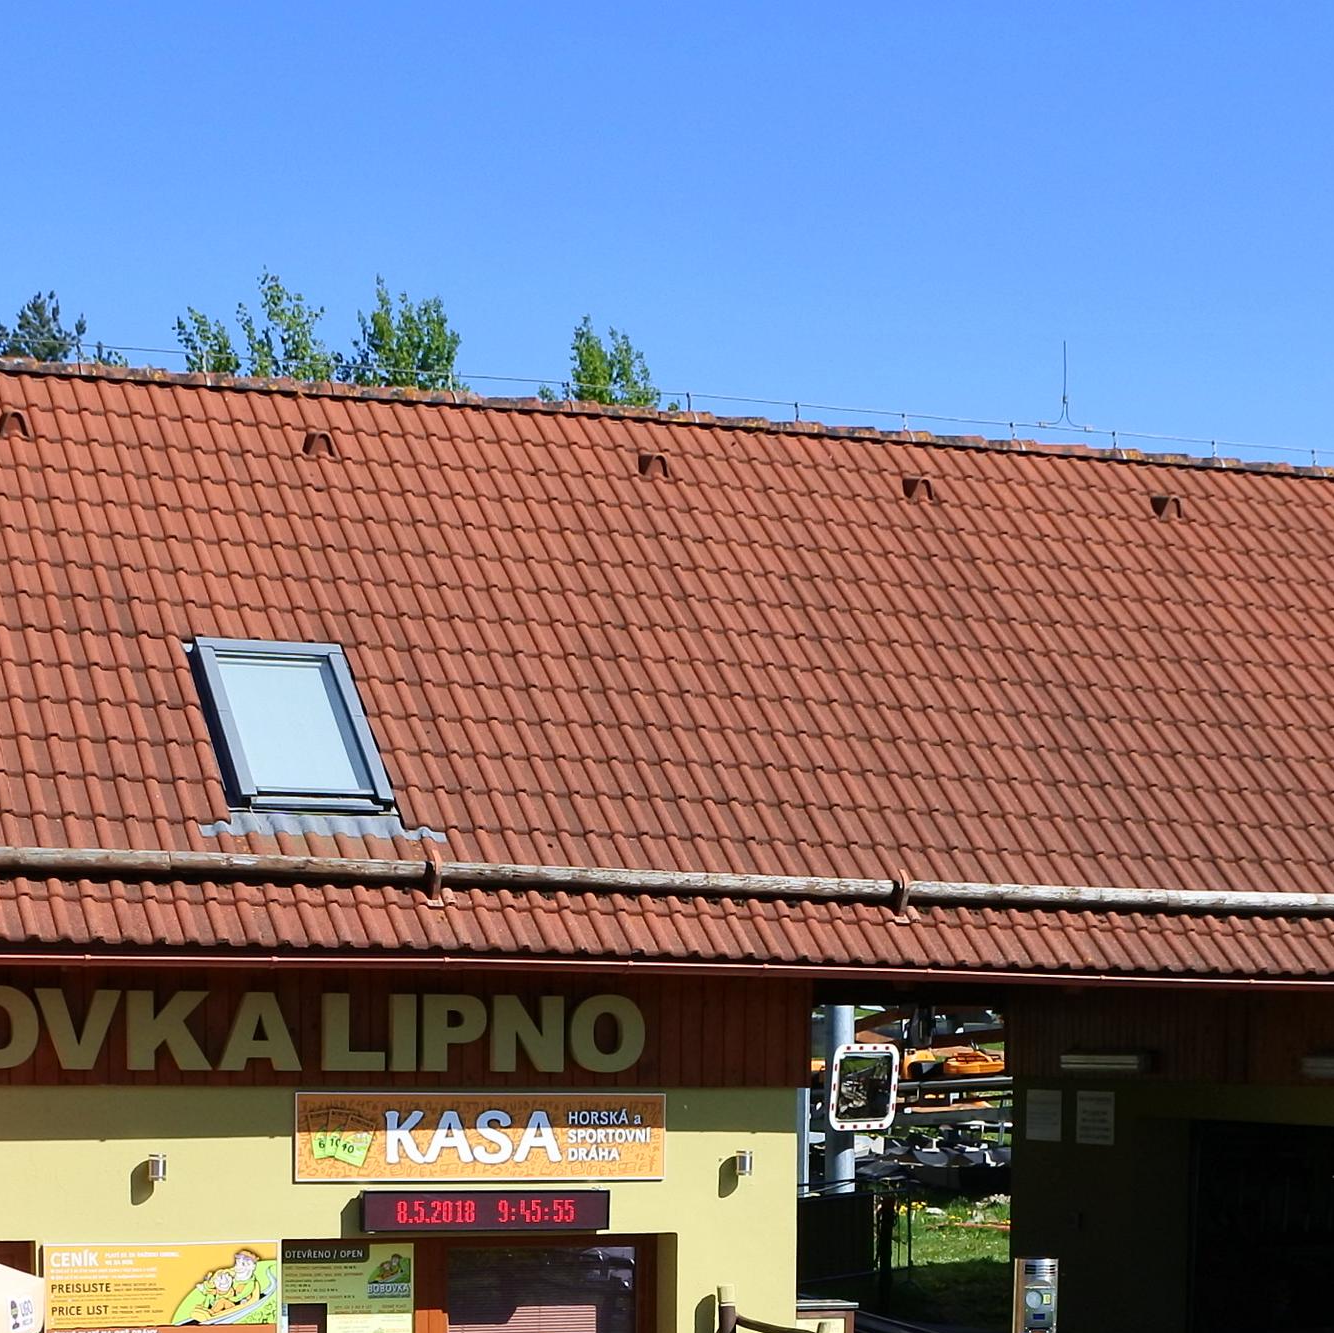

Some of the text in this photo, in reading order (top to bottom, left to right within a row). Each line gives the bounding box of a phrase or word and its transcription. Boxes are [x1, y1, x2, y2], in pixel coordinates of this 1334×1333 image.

[321, 993, 645, 1073] LIPNO
[568, 1109, 642, 1125] HORSKÁ a
[385, 1110, 562, 1164] KASA
[567, 1127, 651, 1144] SPORTOVNÍ
[318, 1140, 326, 1149] 6
[567, 1145, 620, 1162] DRÁHA
[395, 1199, 575, 1224] 8.5.2018 9:45:55
[50, 1249, 99, 1267] CENÍK
[285, 1249, 331, 1259] OTEVŘENO
[340, 1249, 364, 1258] OPEN
[51, 1283, 111, 1293] PREISLISTE
[367, 1282, 411, 1293] BOBOVKA
[51, 1305, 82, 1316] PRICE
[87, 1304, 109, 1316] LIST
